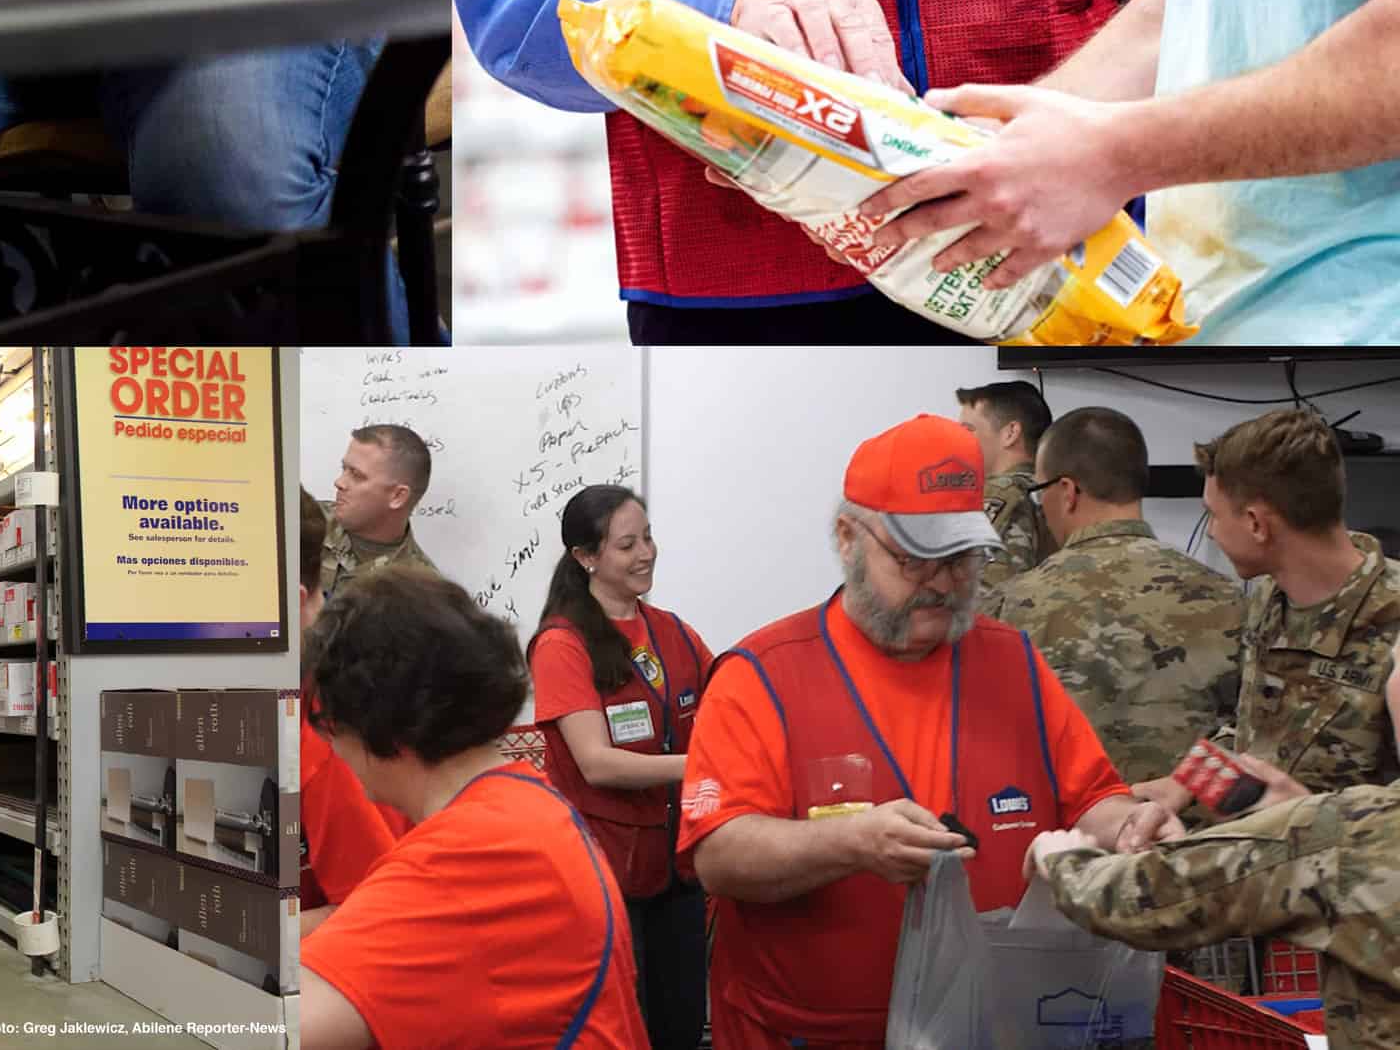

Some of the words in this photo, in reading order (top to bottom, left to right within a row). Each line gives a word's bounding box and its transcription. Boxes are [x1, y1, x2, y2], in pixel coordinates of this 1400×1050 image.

[108, 346, 247, 382] SPECIAL
[110, 376, 247, 421] ORDER
[114, 420, 174, 439] Pedido
[177, 427, 247, 444] especial
[121, 495, 169, 511] More
[173, 497, 240, 516] options
[139, 515, 225, 531] available.
[128, 533, 144, 542] See
[145, 533, 193, 544] salesperson
[194, 534, 207, 543] for
[116, 555, 138, 565] Mas
[140, 556, 187, 567] opciones
[189, 557, 249, 568] disponibles.
[209, 702, 219, 734] roth
[196, 717, 205, 751] allen
